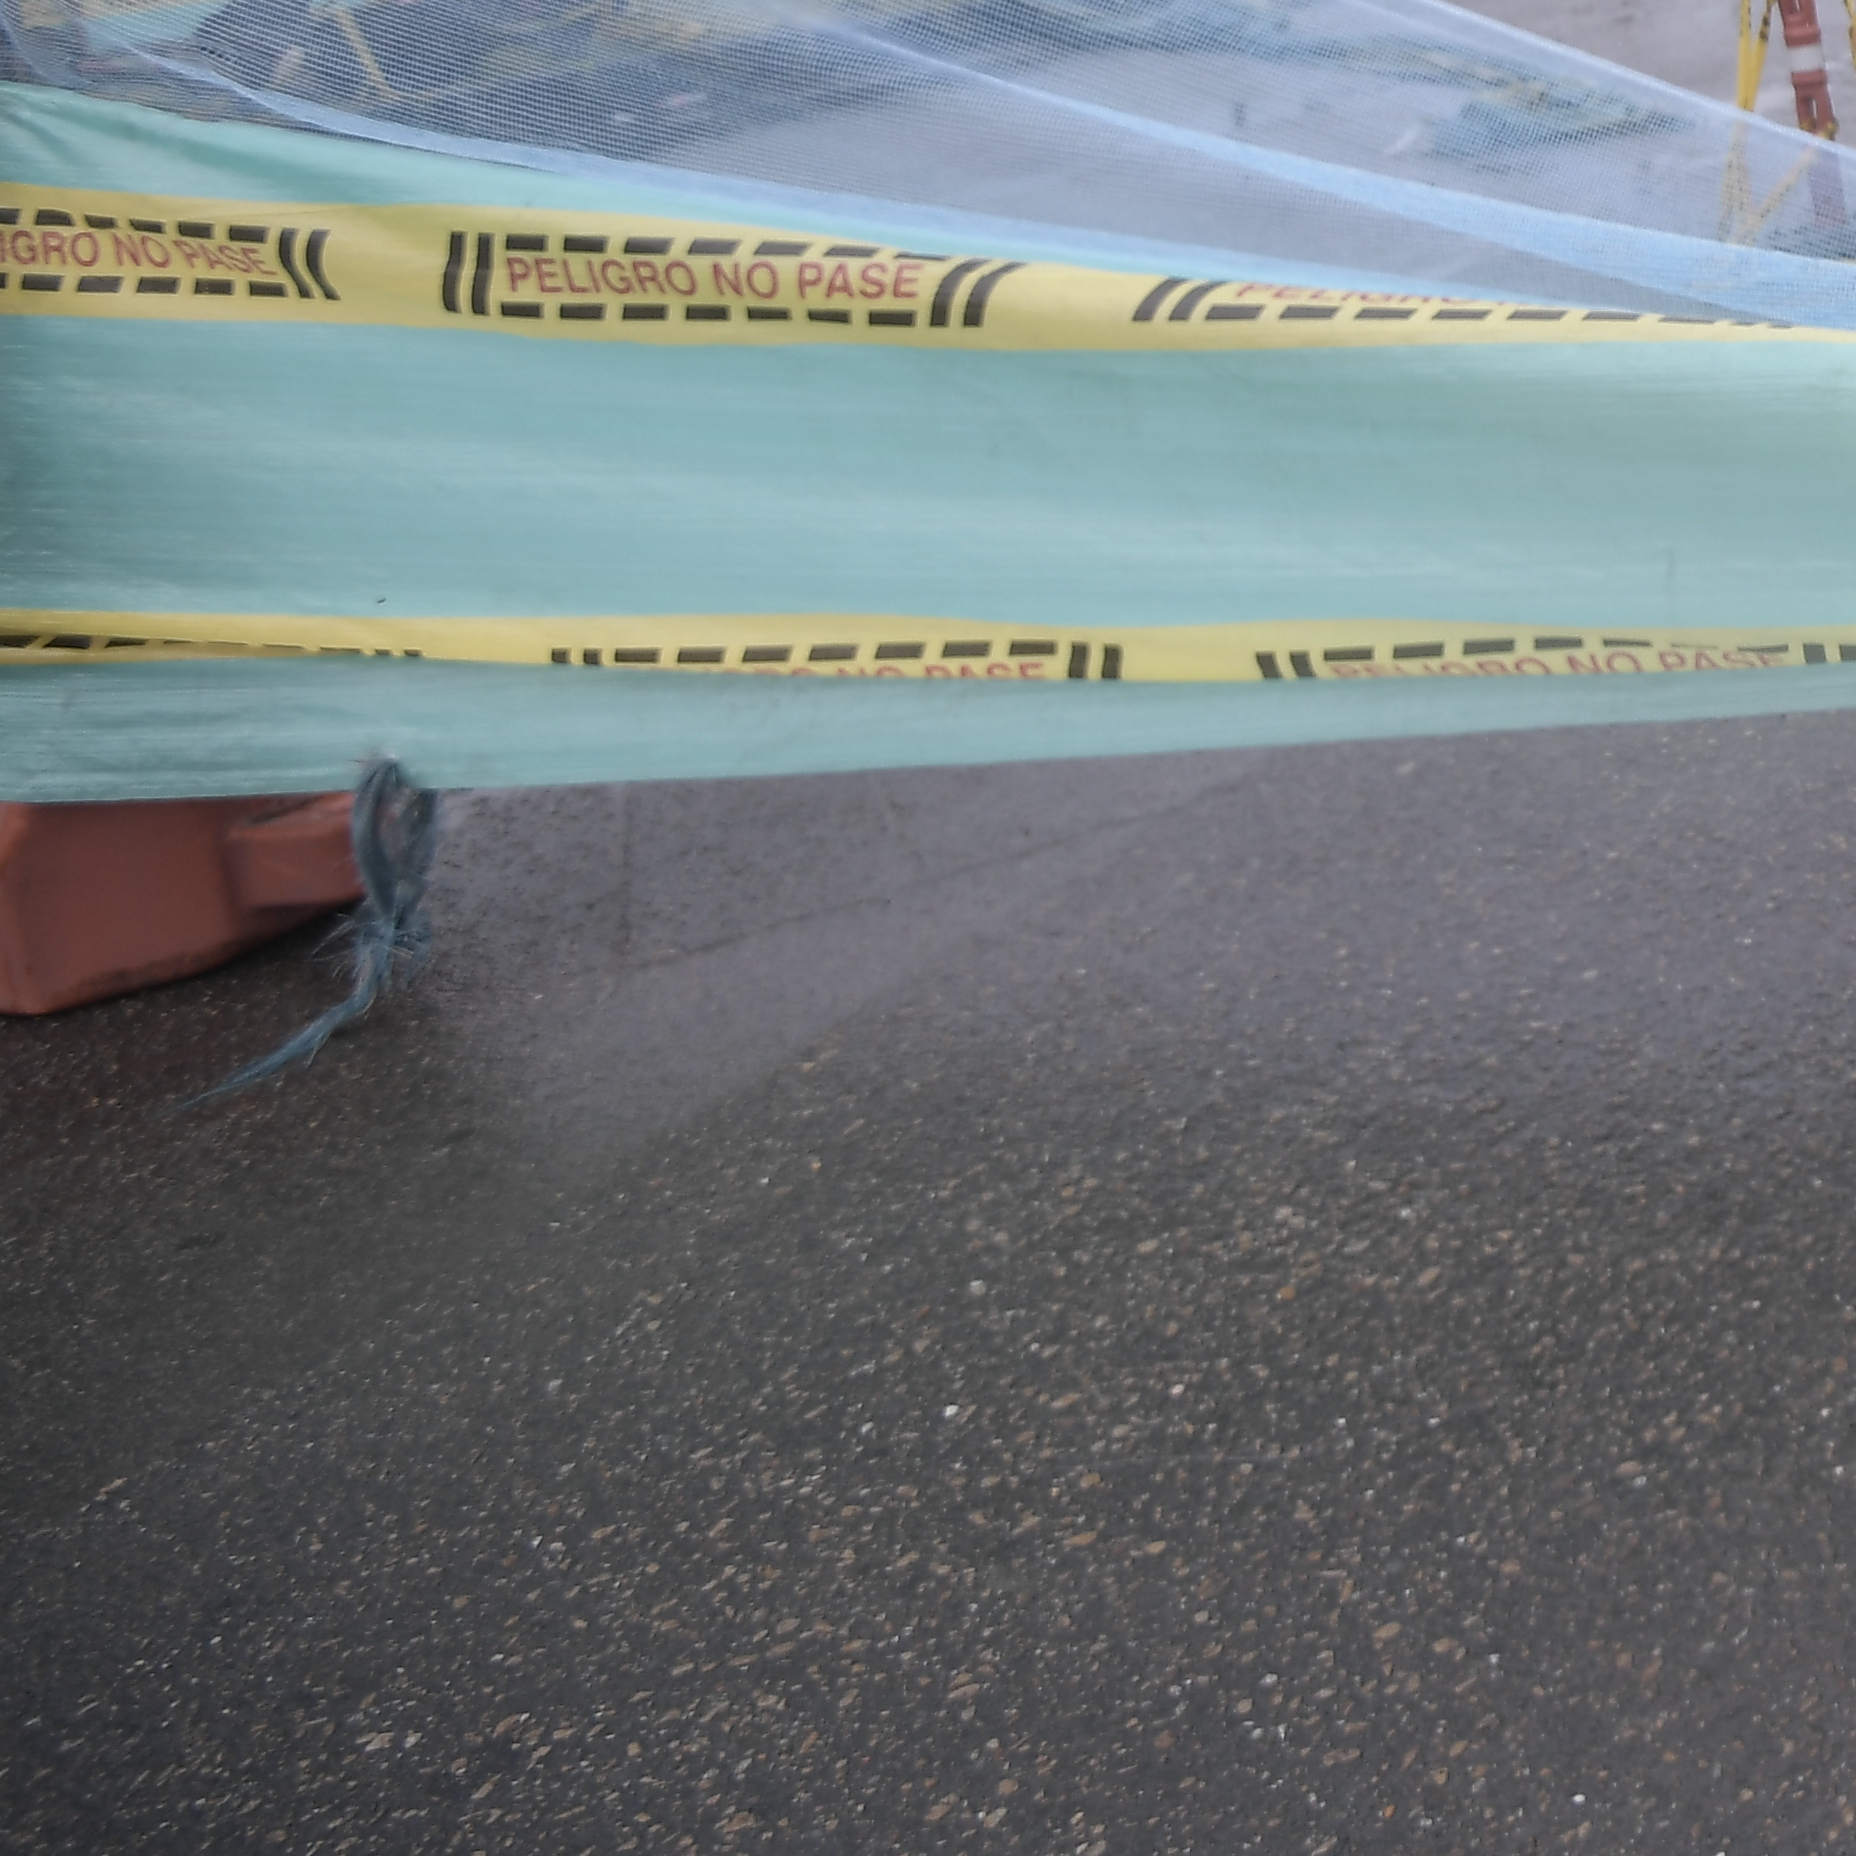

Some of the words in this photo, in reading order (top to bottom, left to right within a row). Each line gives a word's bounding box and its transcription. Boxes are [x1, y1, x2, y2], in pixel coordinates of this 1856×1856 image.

[112, 233, 171, 268] NO
[173, 240, 277, 276] PASE
[507, 256, 697, 296] PELIGRO
[712, 260, 780, 299] NO
[799, 260, 924, 300] PASE
